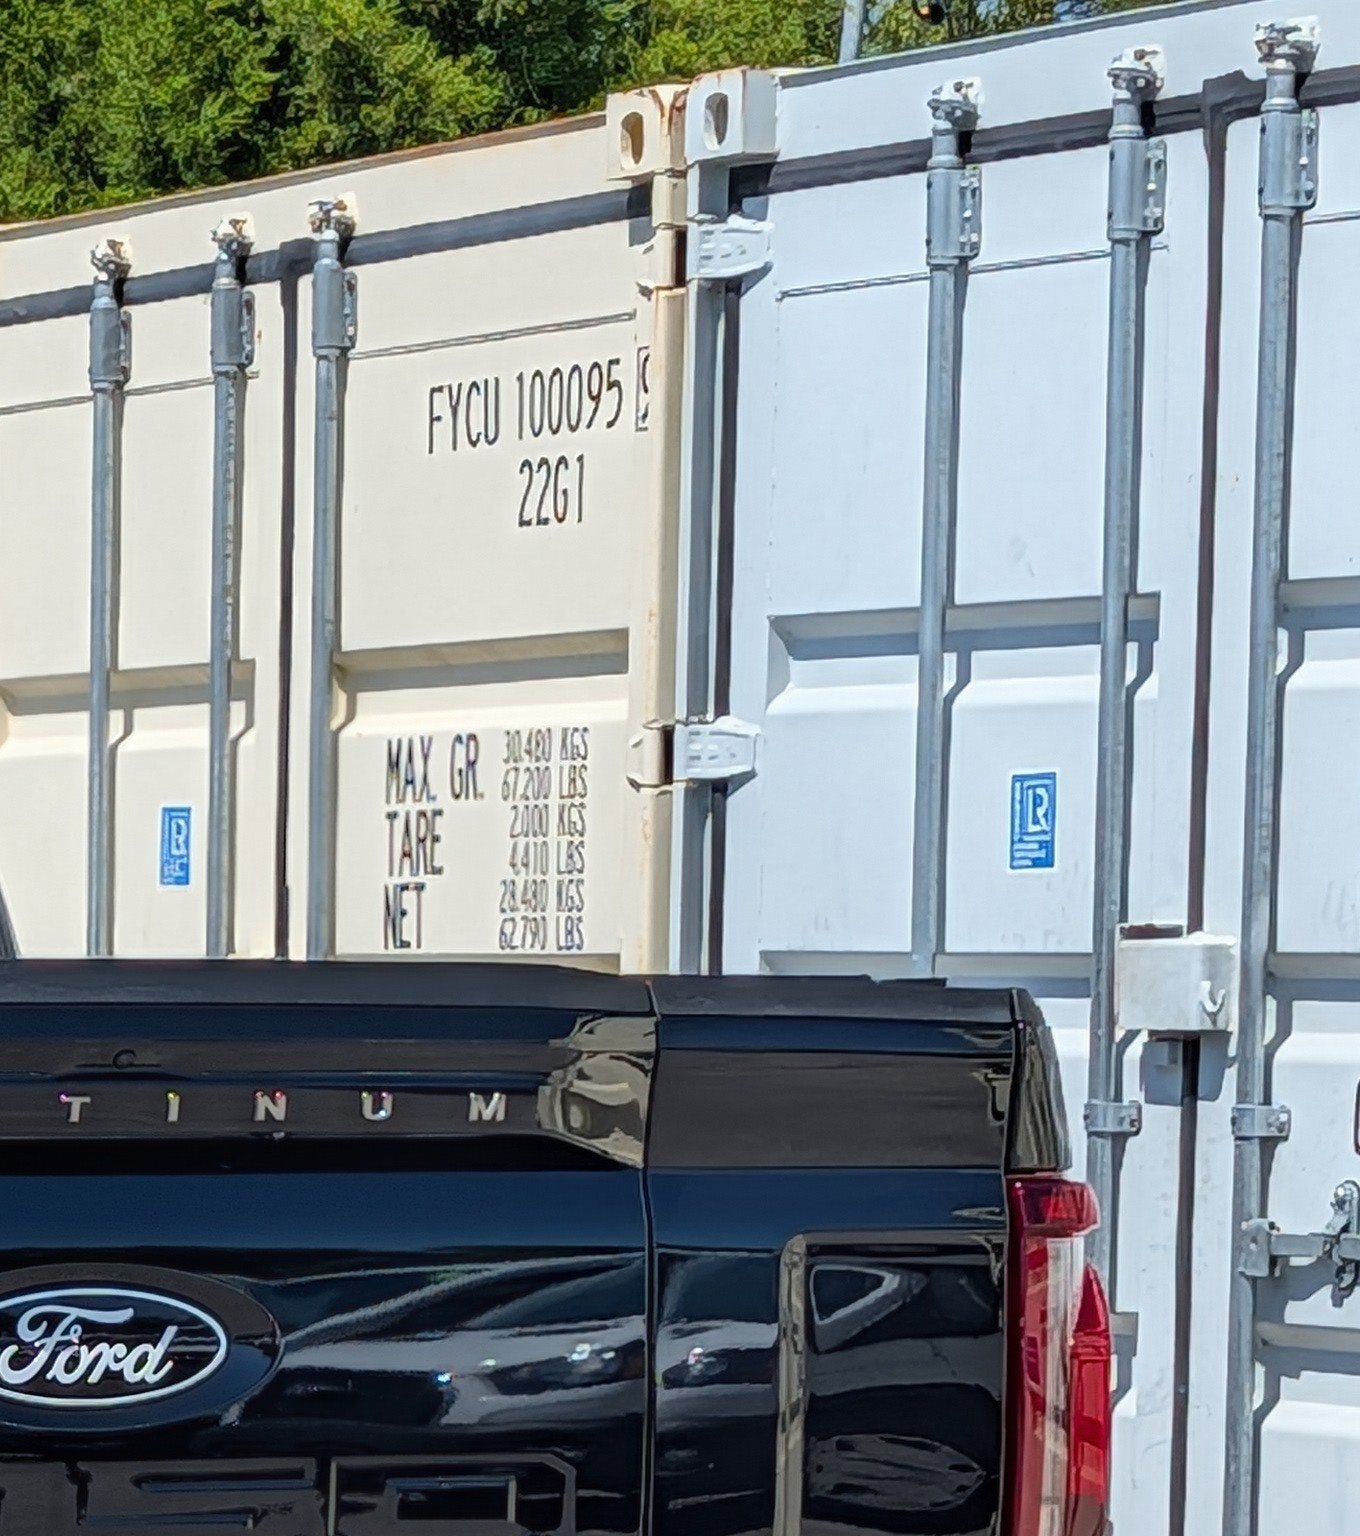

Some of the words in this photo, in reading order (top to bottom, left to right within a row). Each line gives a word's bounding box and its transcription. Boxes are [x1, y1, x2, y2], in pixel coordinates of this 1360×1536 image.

[427, 375, 500, 454] FYCU
[515, 358, 624, 441] 100095
[517, 453, 585, 528] 22G1
[559, 726, 589, 761] KGS
[385, 735, 438, 805] MAX.
[449, 732, 484, 801] GR.
[559, 763, 588, 800] LBS
[556, 802, 586, 838] KGS
[385, 808, 445, 877] TARE
[556, 840, 585, 875] LBS
[556, 878, 585, 913] KGS
[383, 882, 427, 951] NET
[555, 915, 585, 951] LBS
